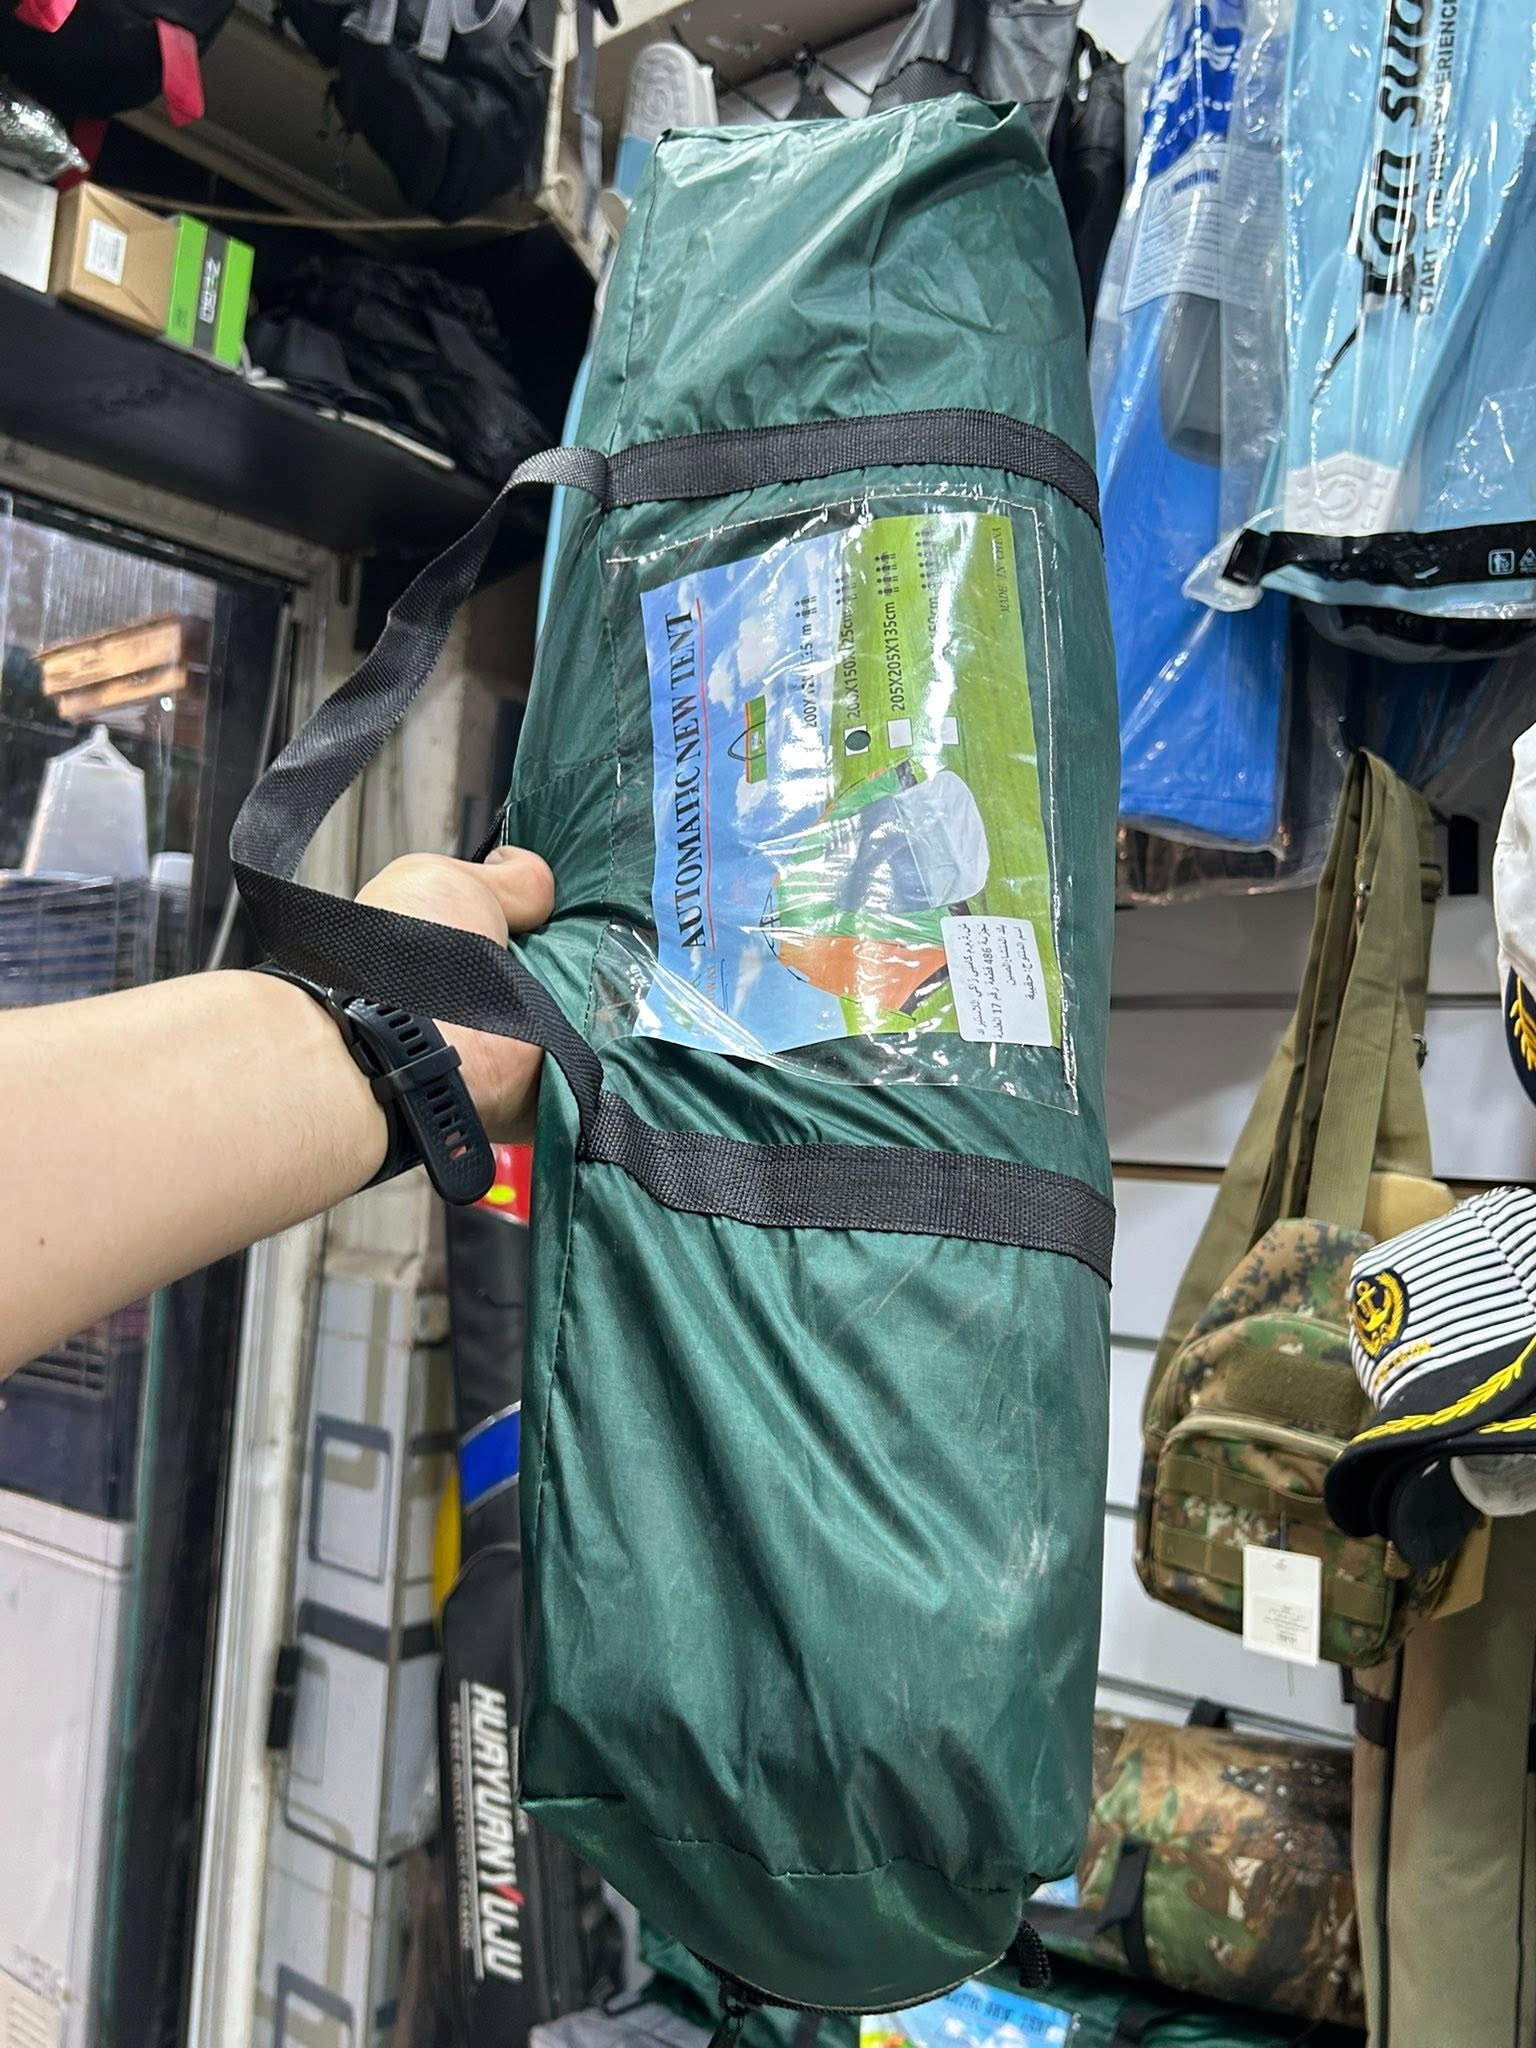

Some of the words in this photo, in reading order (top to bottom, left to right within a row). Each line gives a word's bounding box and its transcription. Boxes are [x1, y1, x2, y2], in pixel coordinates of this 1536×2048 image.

[1417, 247, 1439, 317] START
[990, 527, 1005, 563] CHINA
[995, 563, 1006, 579] IN
[997, 584, 1010, 615] MADE
[664, 609, 695, 691] TENT
[884, 601, 906, 712] 205X205X135cm
[671, 694, 701, 765] NEW
[673, 766, 707, 948] AUTOMATIC
[995, 924, 1008, 936] بلد
[981, 947, 993, 965] 486
[1013, 926, 1026, 941] اسم
[1023, 974, 1038, 1001] حقيبة
[983, 966, 996, 986] قطعة
[988, 986, 1001, 1001] رقم
[991, 1002, 1002, 1014] 17
[470, 1683, 525, 1984] HUAYUANYUJU
